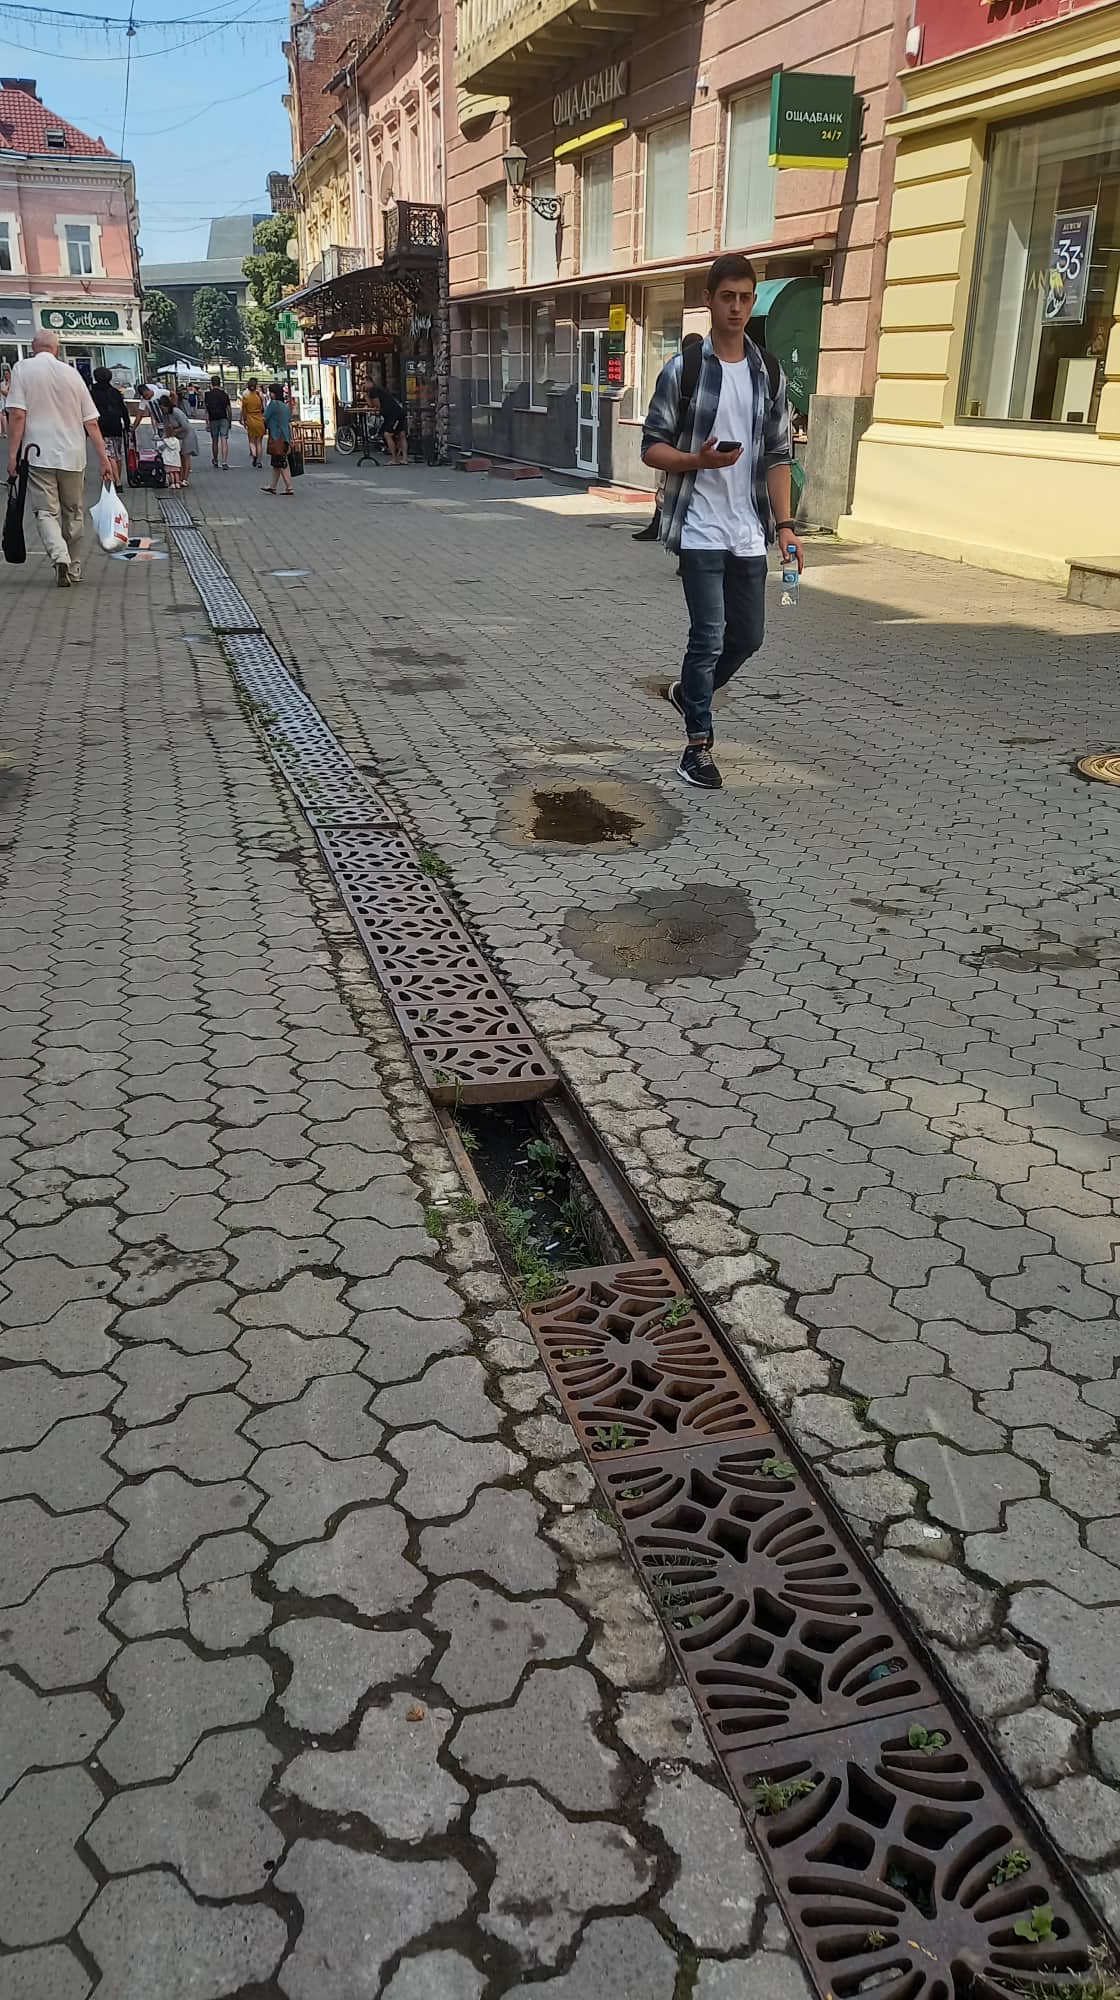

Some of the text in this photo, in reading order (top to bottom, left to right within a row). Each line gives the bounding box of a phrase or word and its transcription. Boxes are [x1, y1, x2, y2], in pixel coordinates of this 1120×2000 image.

[553, 61, 626, 126] ОЩАДБАНК
[785, 110, 843, 124] ОЩАДБАНК
[821, 130, 842, 141] 24/7
[64, 311, 111, 328] Svitlana
